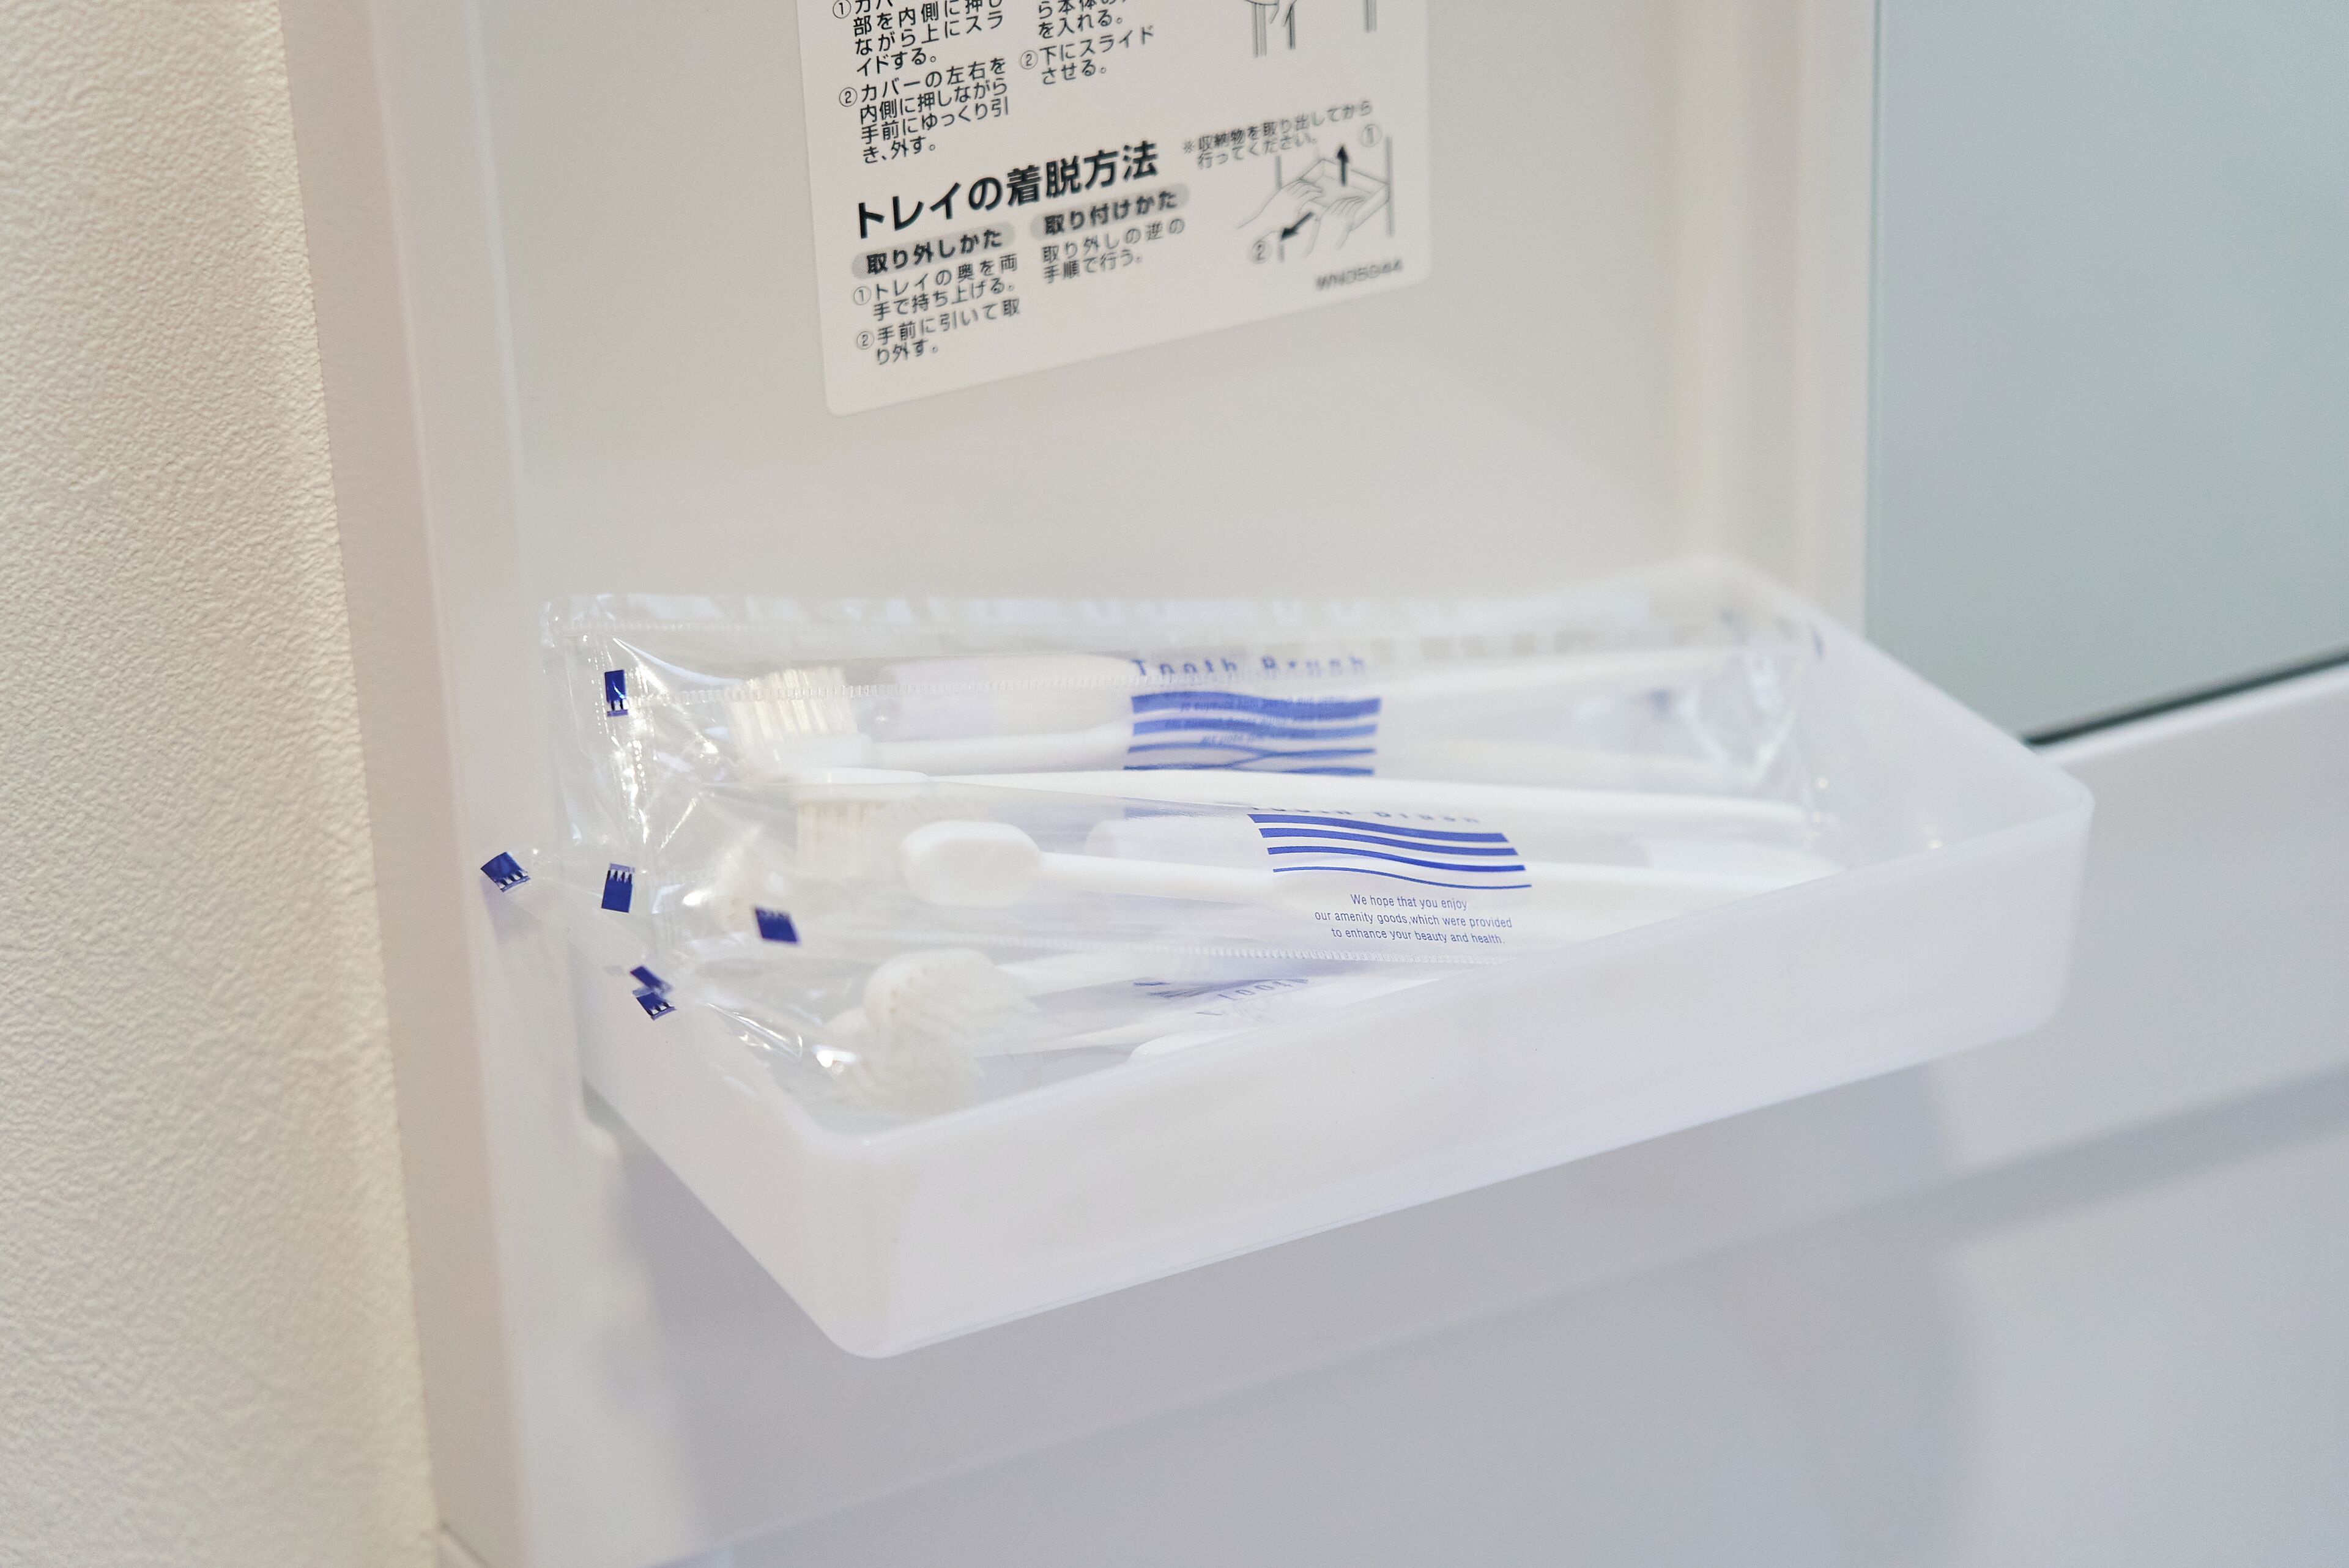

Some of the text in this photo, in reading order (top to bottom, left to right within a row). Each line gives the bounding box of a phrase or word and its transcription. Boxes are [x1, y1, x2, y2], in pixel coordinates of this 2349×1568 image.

[855, 10, 1003, 56] ながら上にスラ
[1039, 9, 1123, 39] を入れる。
[856, 48, 937, 76] イドする。
[1042, 59, 1107, 84] させる。
[860, 77, 1008, 125] 内側に押しながら
[861, 95, 1009, 145] 手前にゆっくり引
[863, 136, 936, 164] き、外す。
[858, 140, 1159, 239] トレイの着脱方法
[1044, 190, 1178, 235] 取り付けかた
[866, 229, 1004, 275] 取り外しかた
[1042, 218, 1186, 264] 取り外しの逆の
[1043, 248, 1143, 284] 手順で行う。
[873, 277, 1015, 322] 手で持ち上げる。
[877, 339, 938, 366] り外す。
[1315, 911, 1331, 921] our
[1335, 911, 1373, 924] amenity
[1442, 917, 1466, 926] were
[1469, 917, 1513, 929] provided
[1351, 893, 1468, 911] We hope that you enjoy
[1331, 927, 1505, 944] to enhance your beauty and health.
